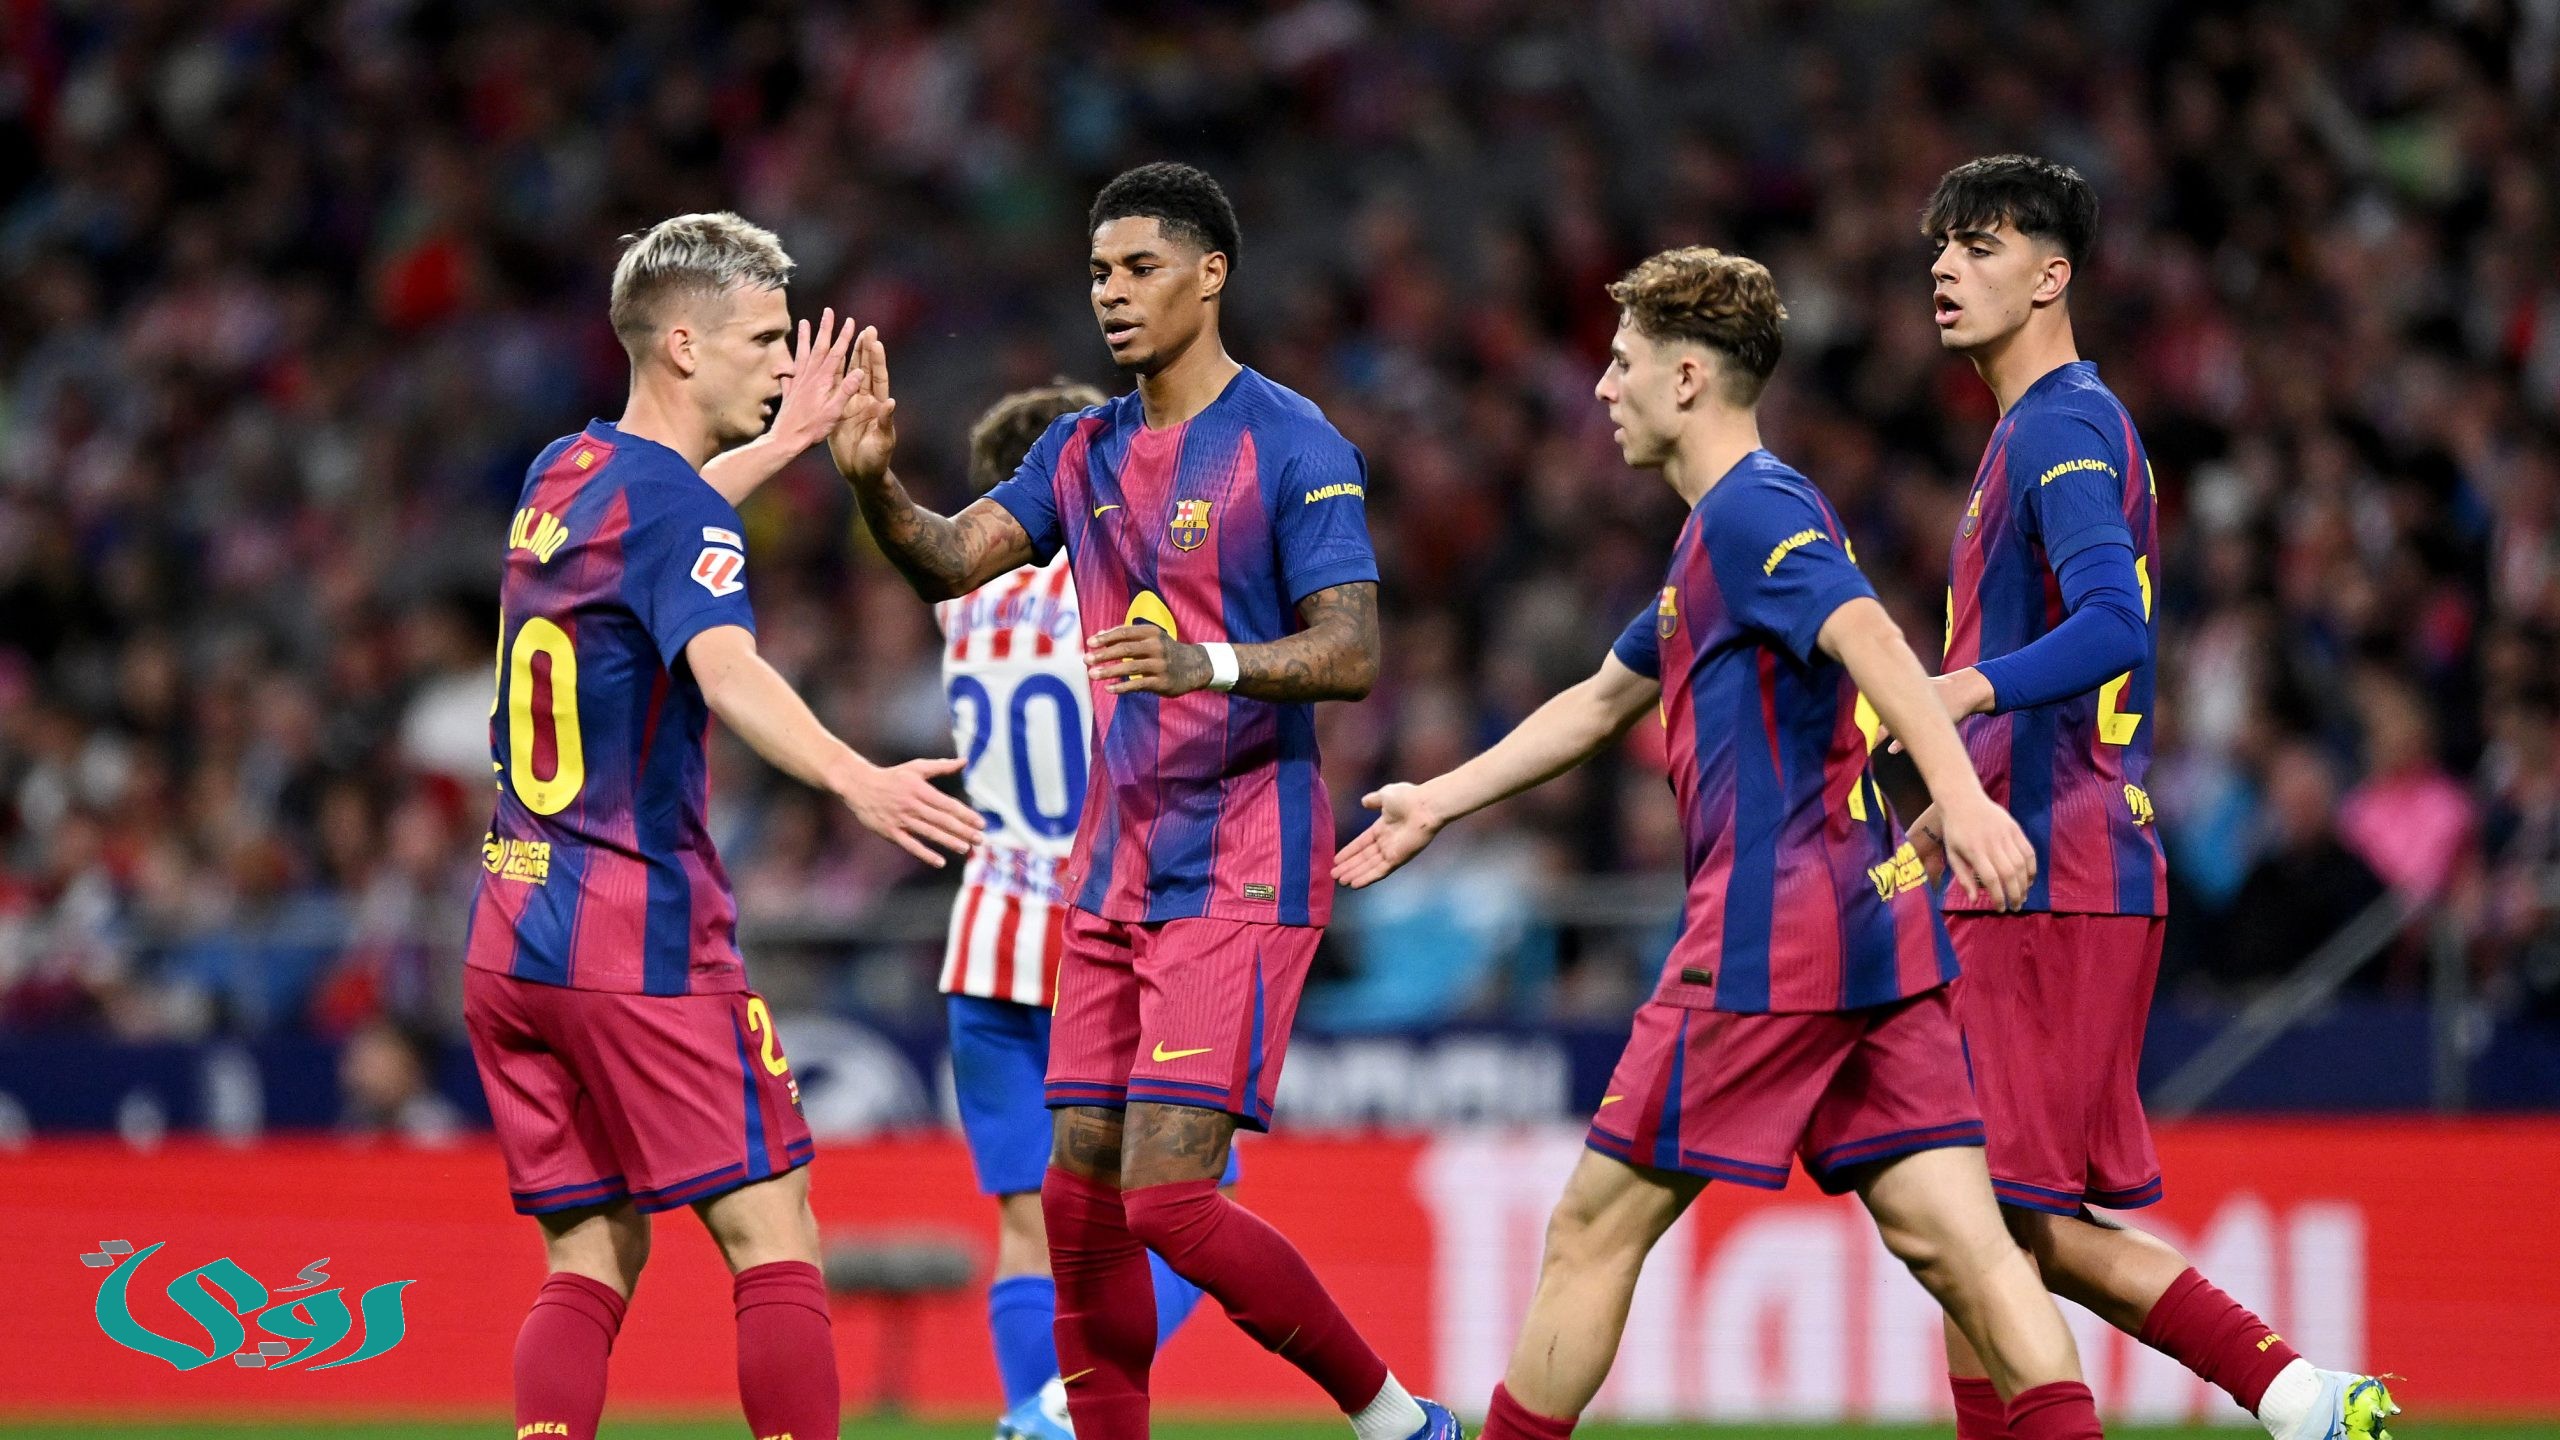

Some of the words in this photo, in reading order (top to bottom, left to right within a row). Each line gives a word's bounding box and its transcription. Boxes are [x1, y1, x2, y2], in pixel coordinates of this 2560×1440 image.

[1305, 483, 1362, 505] AMBILIGHT
[2040, 459, 2107, 487] AMBILIGHT
[509, 507, 569, 564] OLMO
[490, 606, 585, 815] 0
[951, 673, 1092, 840] 20
